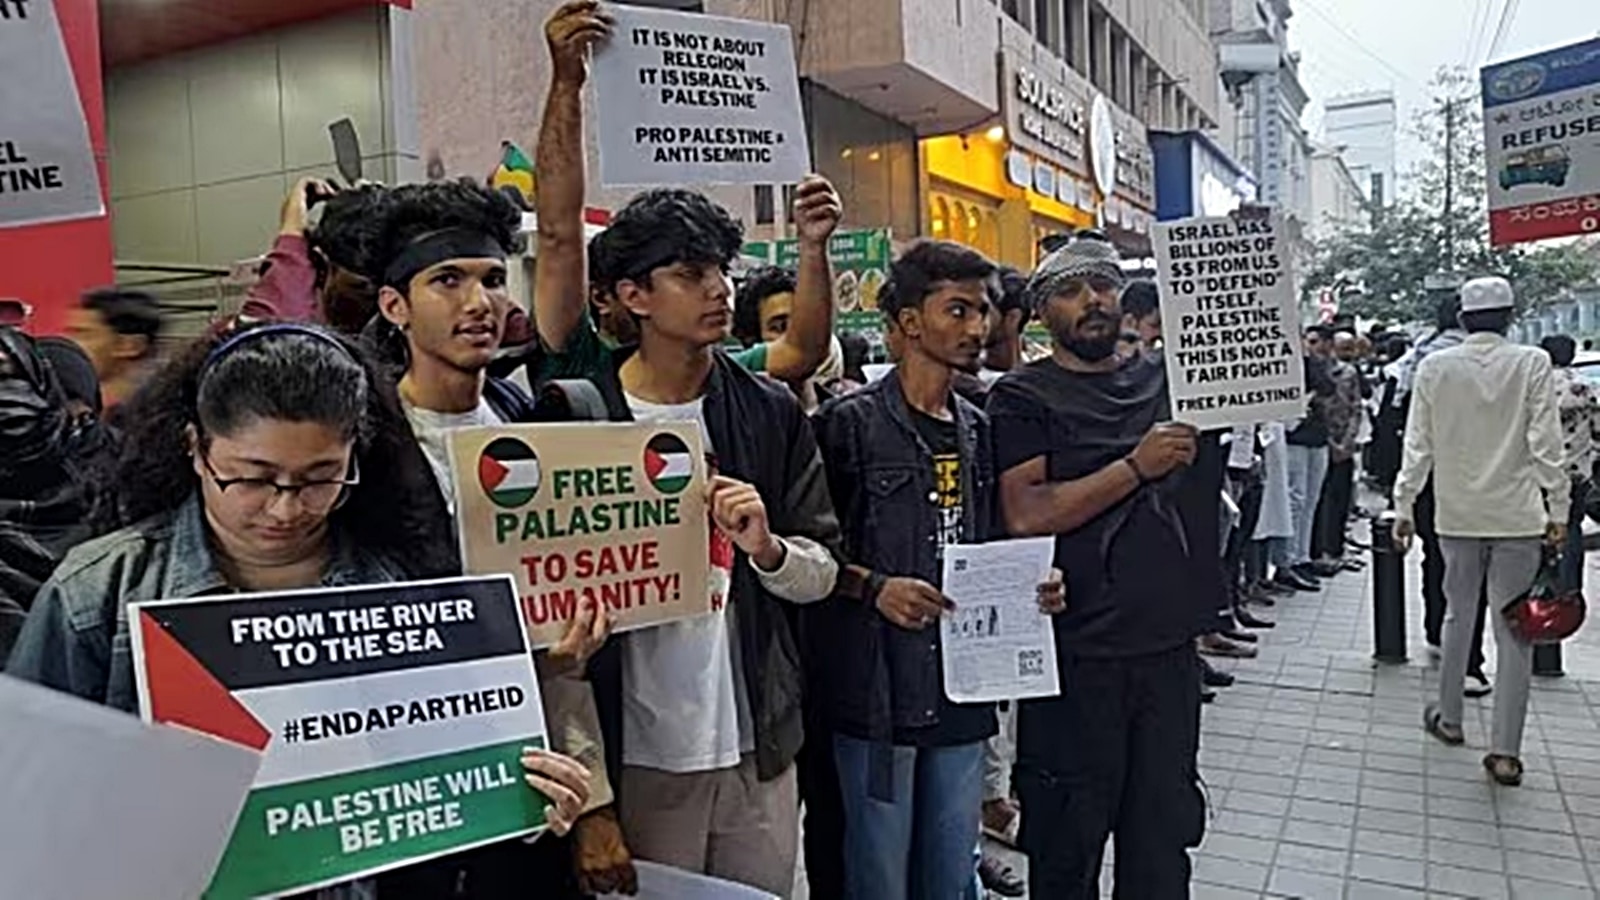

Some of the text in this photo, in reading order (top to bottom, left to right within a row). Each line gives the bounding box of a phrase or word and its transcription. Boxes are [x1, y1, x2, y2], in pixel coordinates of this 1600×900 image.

[633, 28, 765, 57] IT IS NOT ABOUT
[640, 69, 770, 92] IT IS ISRAEL VS.
[661, 89, 757, 109] PALESTINE
[636, 127, 676, 143] PRO
[679, 127, 774, 145] PALESTINE
[1502, 116, 1600, 150] REFUSE
[654, 147, 772, 163] ANTI SEMITIC
[1168, 219, 1273, 241] ISRAEL HAS
[1169, 237, 1276, 260] BILLIONS OF
[1197, 256, 1249, 275] FROM
[1169, 270, 1284, 295] TO "DEFEND"
[1182, 308, 1280, 330] PALESTINE
[1180, 325, 1286, 349] HAS ROCKS.
[1176, 342, 1293, 367] THIS IS NOT A
[1186, 361, 1288, 384] FAIR FIGHT!
[1178, 387, 1301, 412] FREE PALESTINE!
[553, 466, 635, 500] FREE
[495, 497, 681, 543] PALASTINE
[521, 541, 660, 586] TO SAVE
[231, 599, 475, 643] FROM THE RIVER
[274, 628, 444, 667] TO THE SEA
[283, 686, 524, 743] #ENDAPARTHEID
[267, 763, 516, 835] PALESTINE WILL
[340, 803, 463, 853] BE FREE
